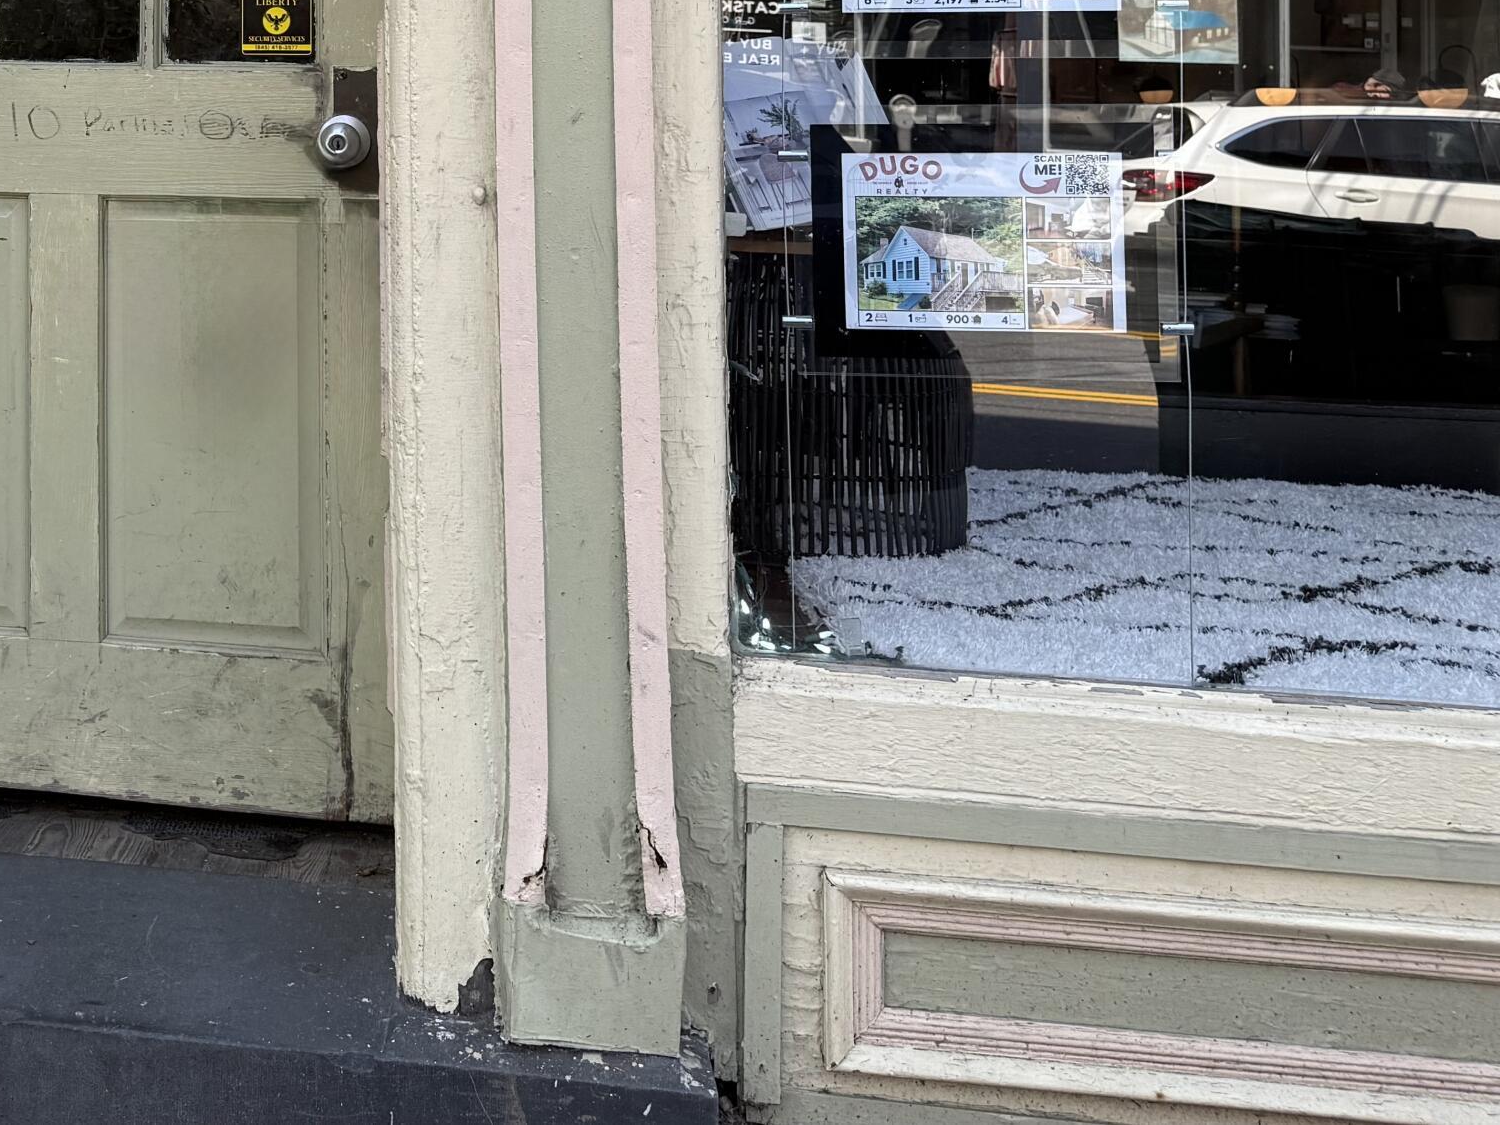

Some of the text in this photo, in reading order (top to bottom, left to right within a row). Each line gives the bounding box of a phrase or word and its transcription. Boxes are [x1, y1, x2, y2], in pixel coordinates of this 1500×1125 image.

[1034, 155, 1062, 163] SCAN
[858, 154, 943, 182] DUGO
[1034, 163, 1062, 176] ME!
[865, 313, 1008, 325] 2 1 900 4
